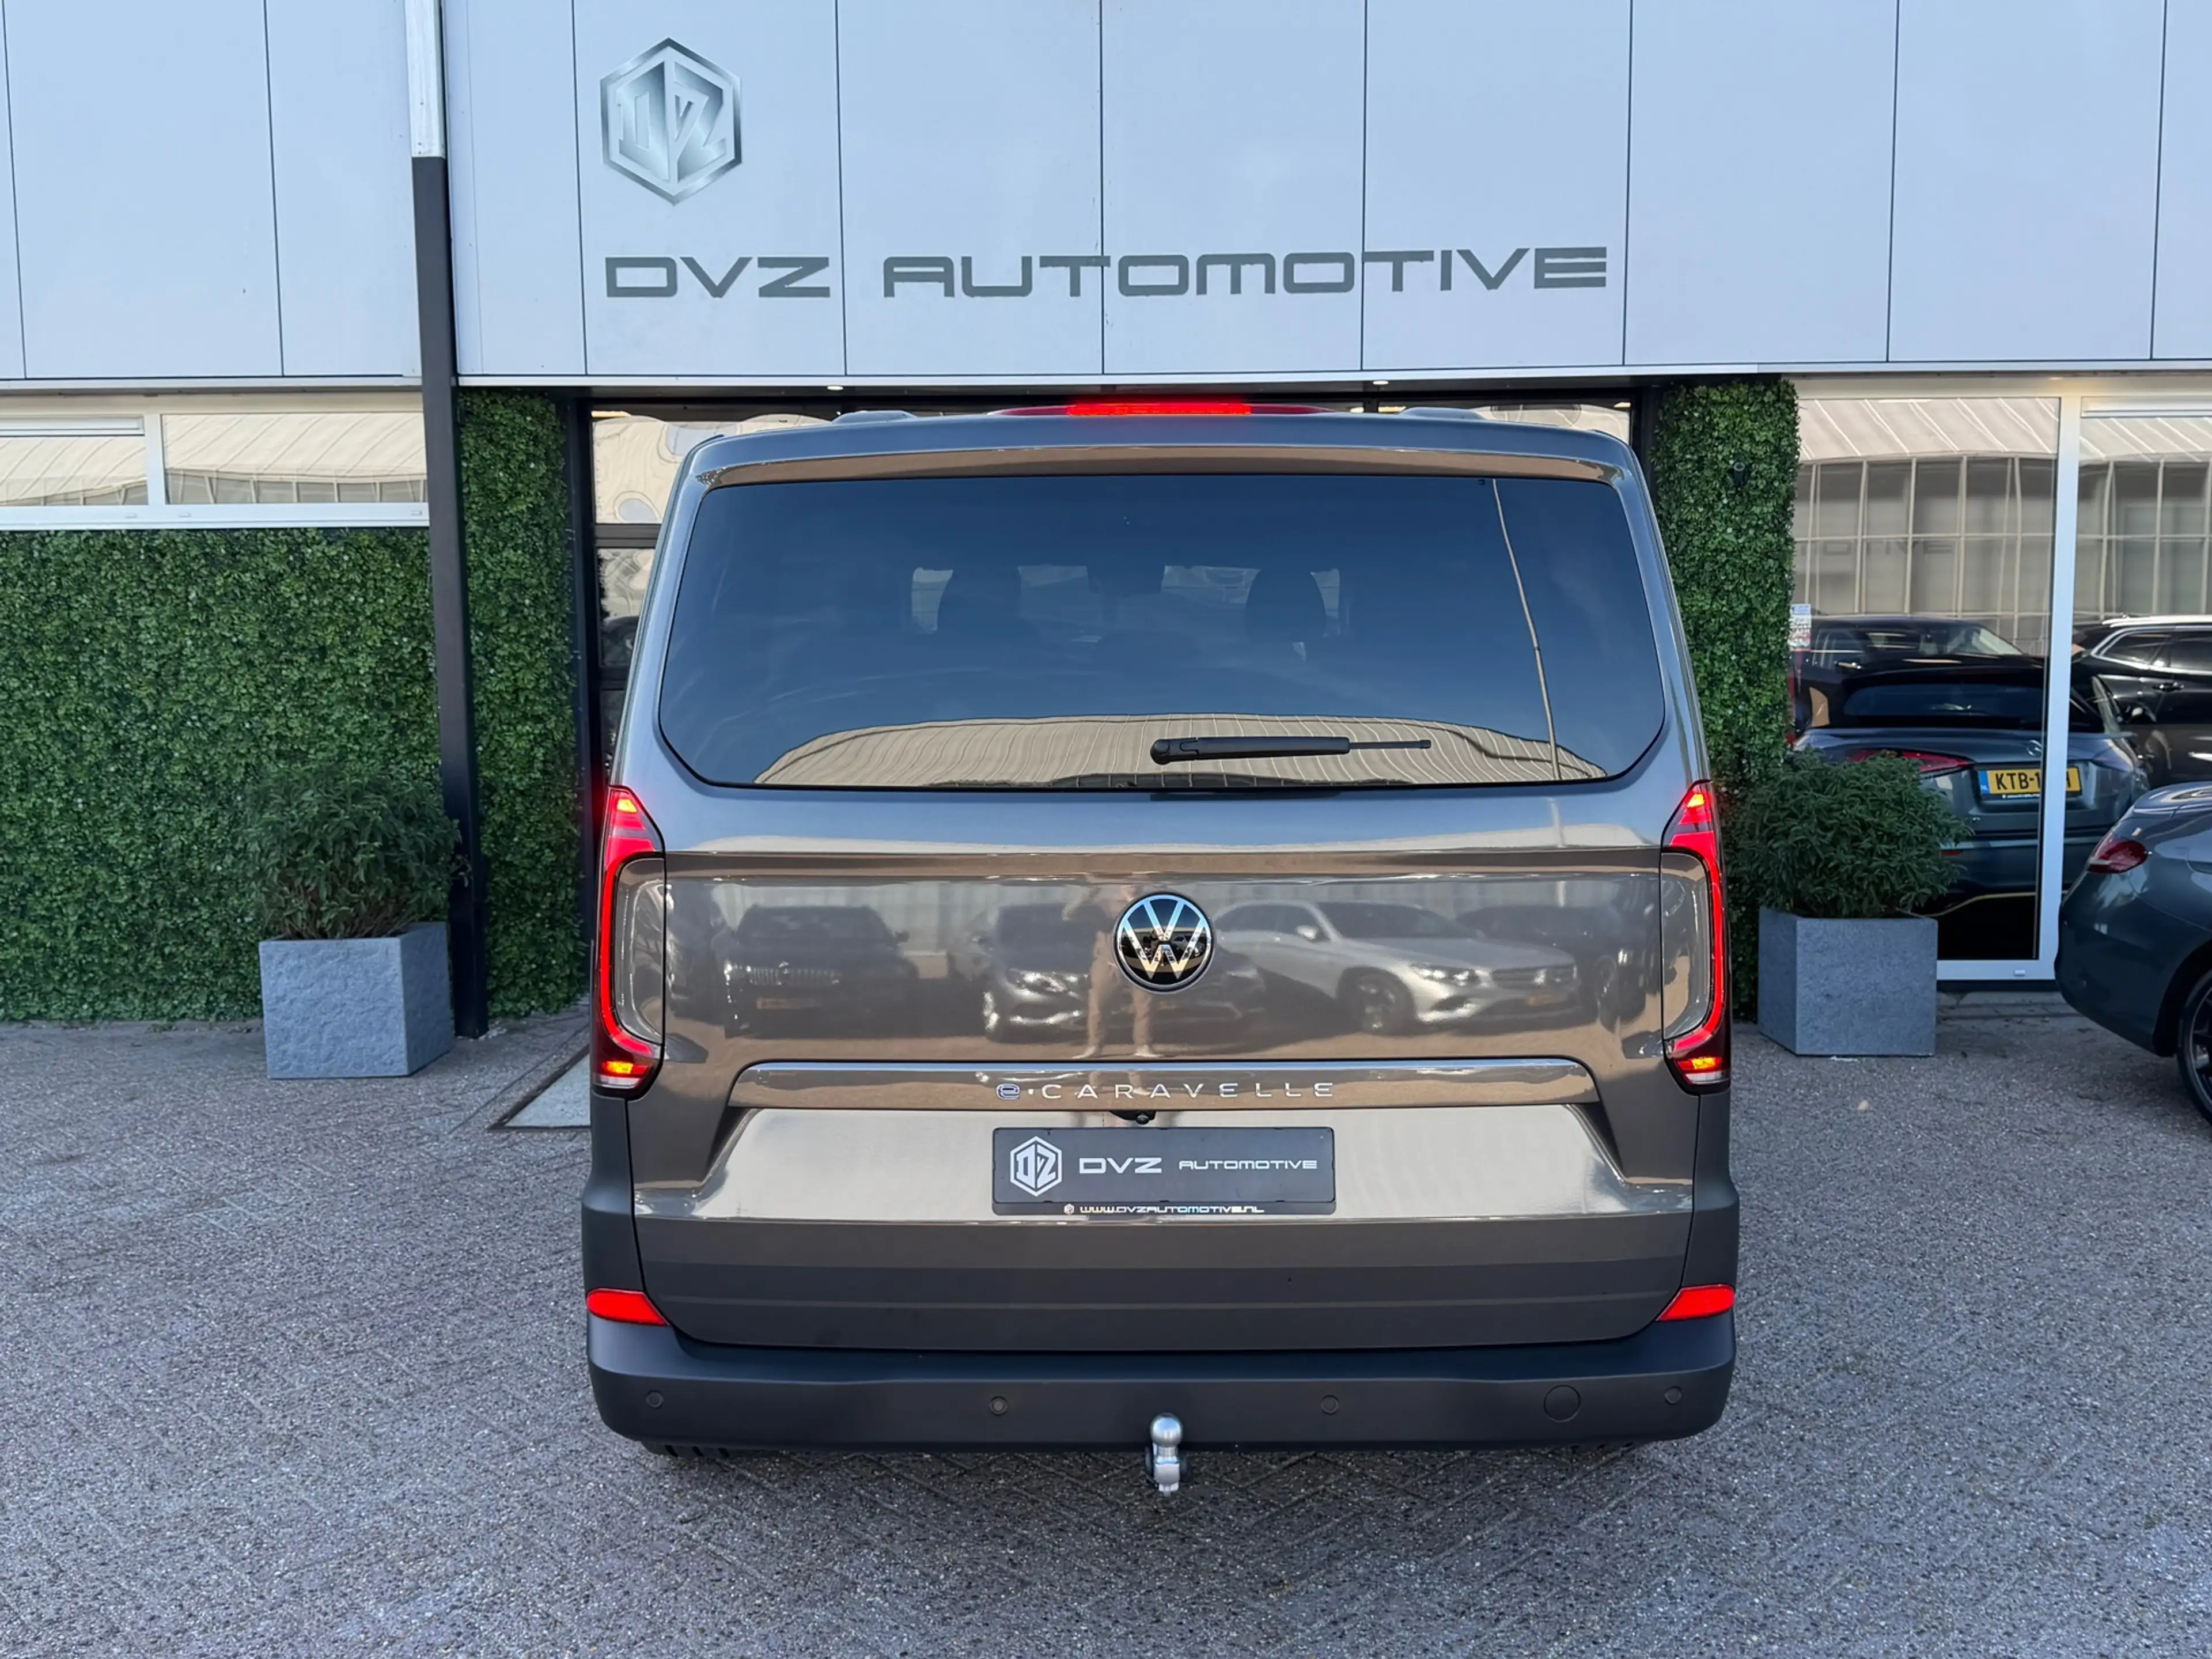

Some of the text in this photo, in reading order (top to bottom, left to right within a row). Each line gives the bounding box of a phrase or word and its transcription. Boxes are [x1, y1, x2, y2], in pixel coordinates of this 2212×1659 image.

[605, 247, 1607, 298] DVZ AUTOMOTIVE
[1079, 1157, 1318, 1174] DVZ AUTOMOTIVE
